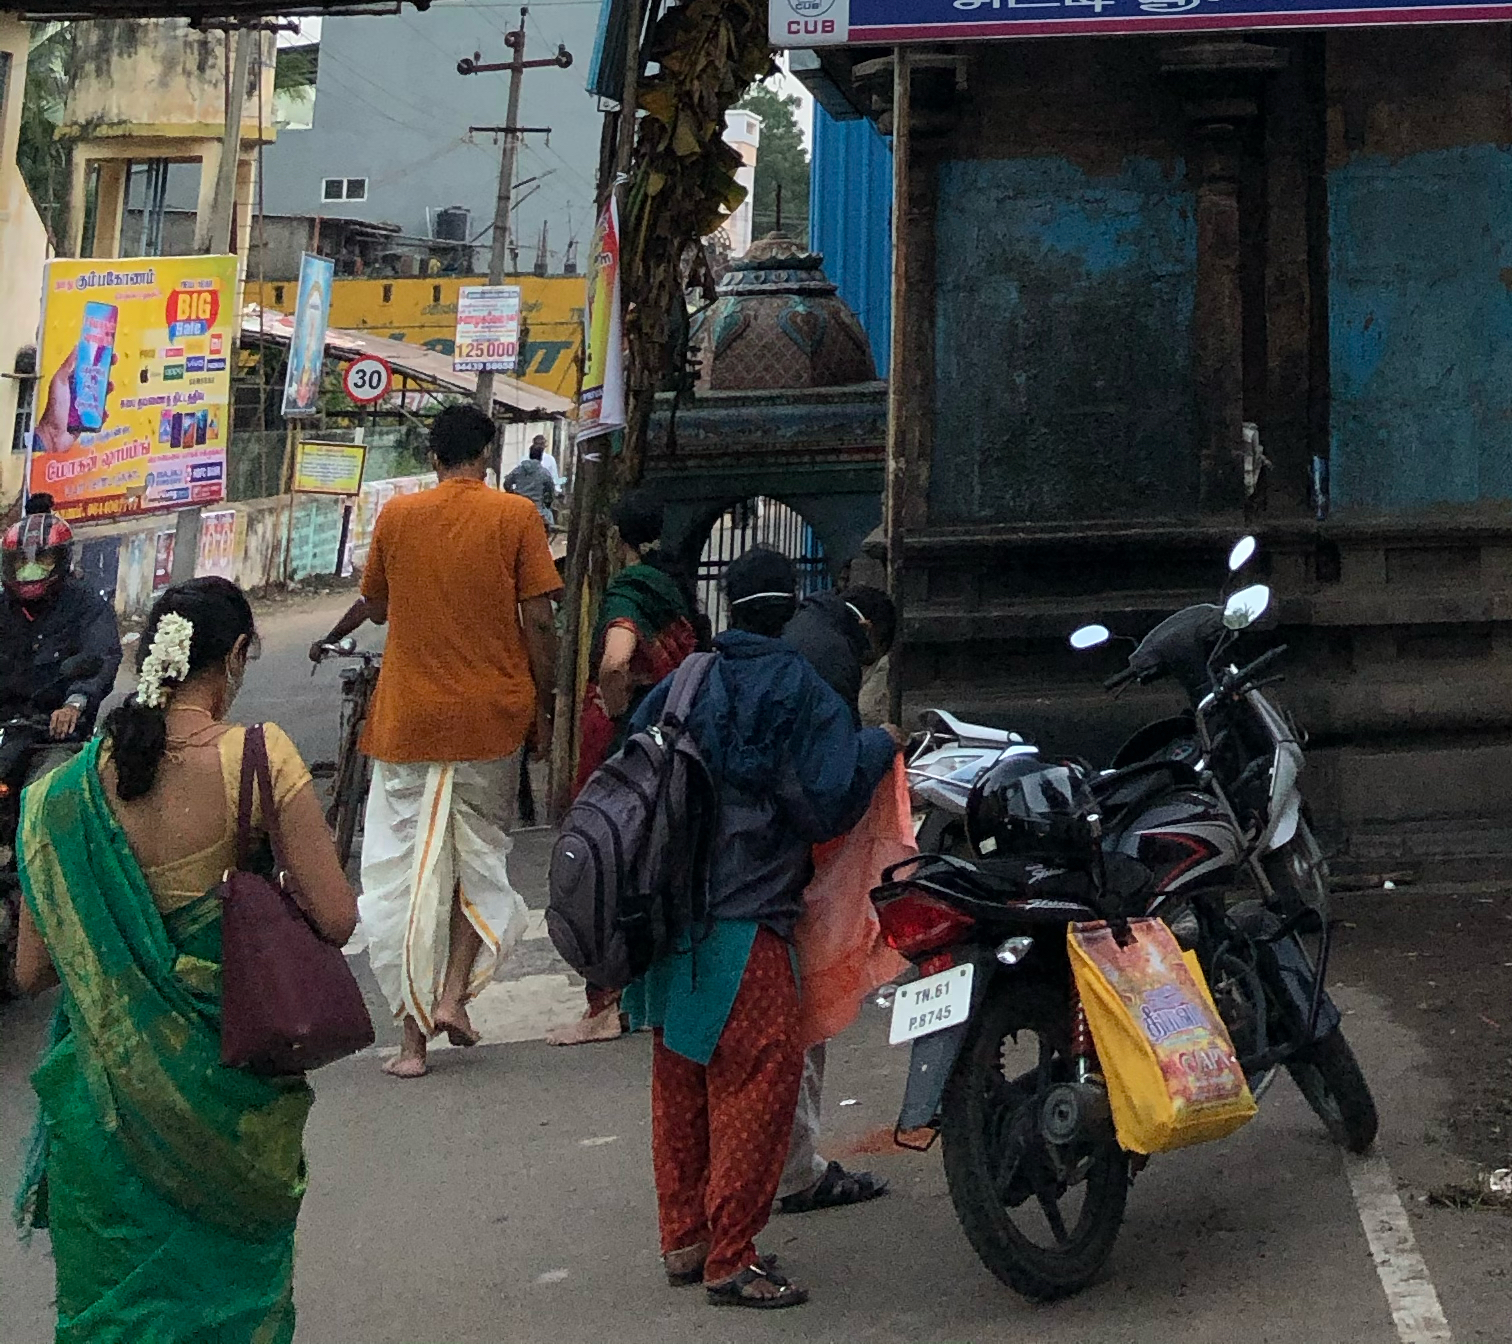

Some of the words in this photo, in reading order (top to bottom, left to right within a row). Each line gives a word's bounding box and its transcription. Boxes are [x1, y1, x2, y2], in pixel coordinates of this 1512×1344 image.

[787, 20, 835, 35] CUB
[176, 292, 212, 321] BIG
[175, 322, 202, 337] Sale
[353, 368, 383, 390] 30
